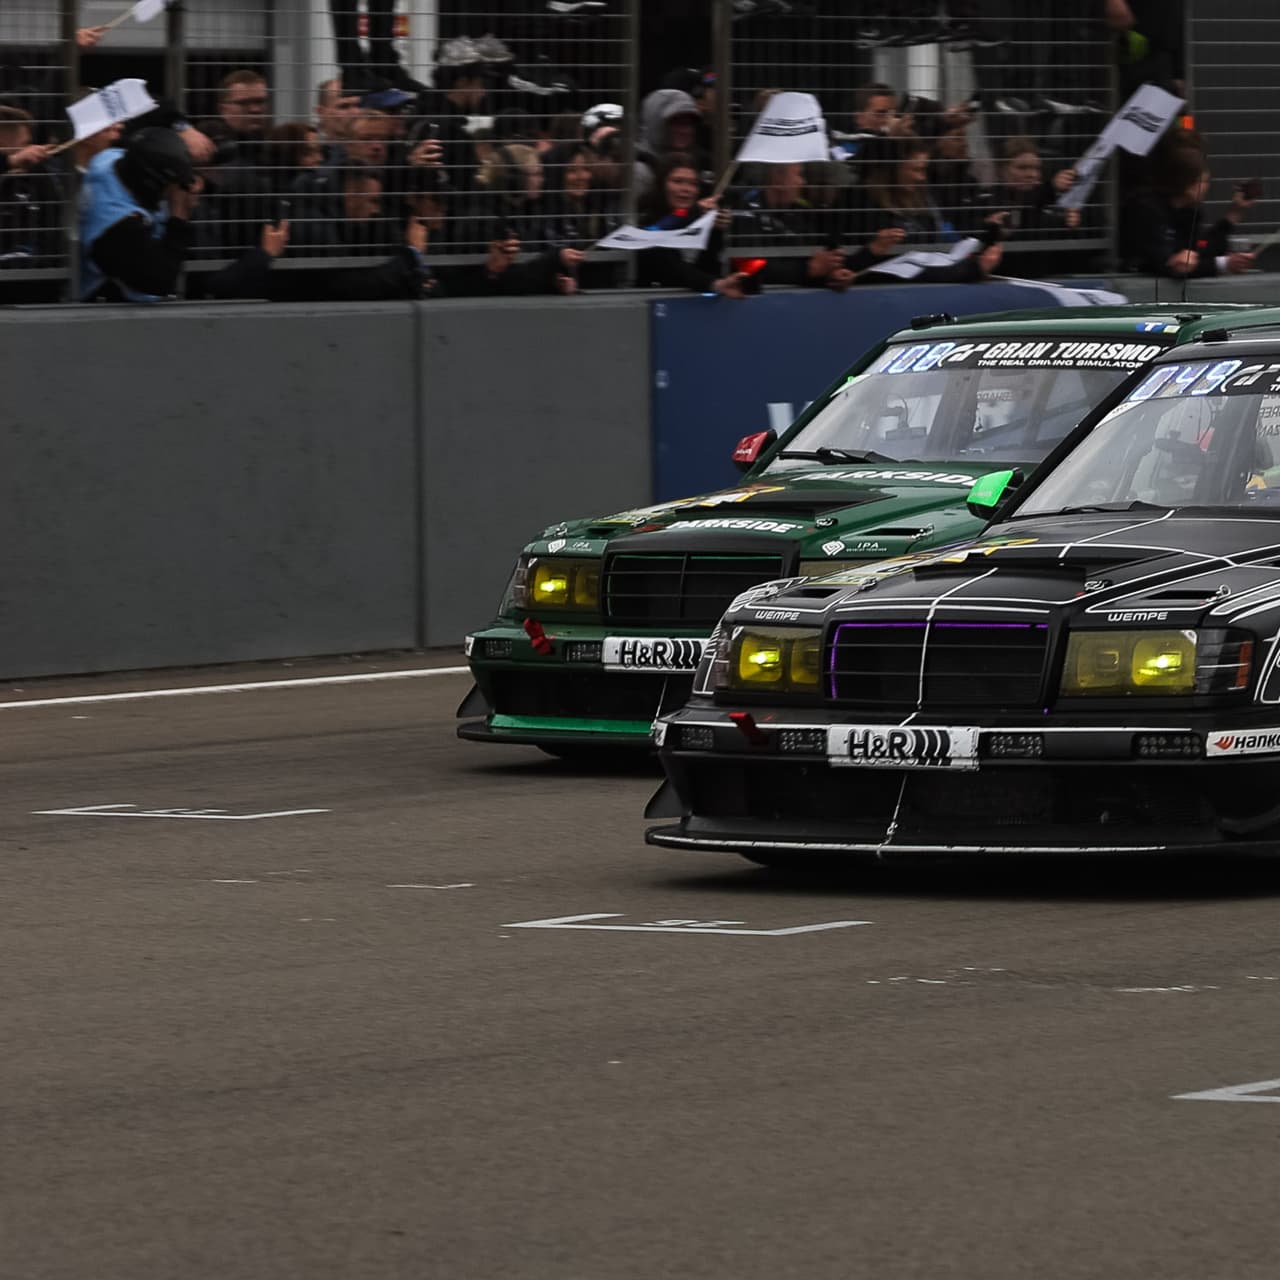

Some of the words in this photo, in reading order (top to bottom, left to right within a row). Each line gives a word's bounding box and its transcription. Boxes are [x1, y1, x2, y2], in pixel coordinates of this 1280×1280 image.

[983, 342, 1052, 359] GRAN
[1051, 342, 1162, 361] TURISMO
[977, 359, 997, 367] THE
[999, 359, 1025, 367] REAL
[1028, 359, 1074, 367] DRIVING
[755, 610, 800, 621] WEMPE
[1108, 611, 1168, 622] WEMPE
[621, 640, 668, 667] H&R
[848, 728, 908, 761] H&R
